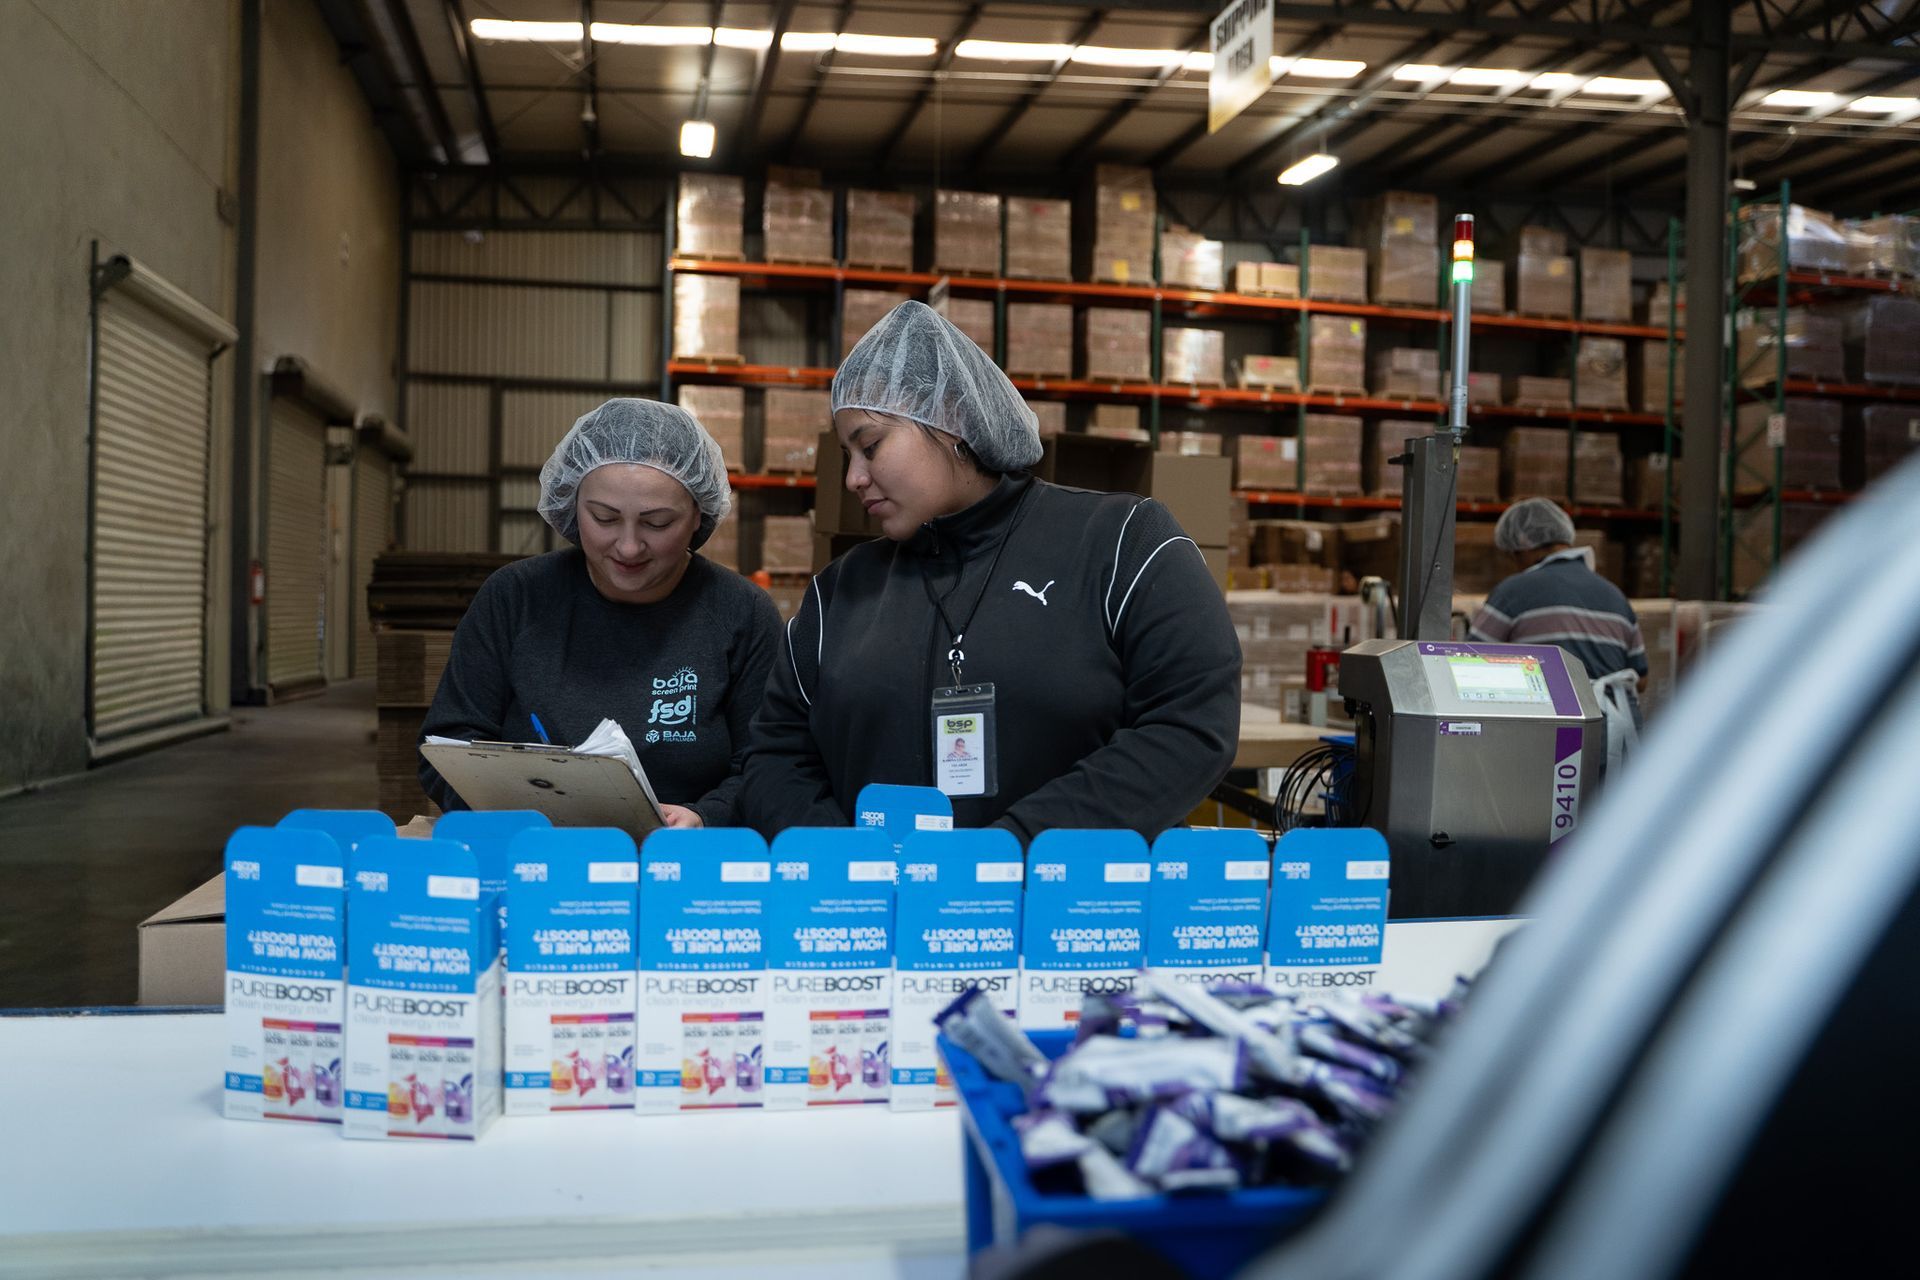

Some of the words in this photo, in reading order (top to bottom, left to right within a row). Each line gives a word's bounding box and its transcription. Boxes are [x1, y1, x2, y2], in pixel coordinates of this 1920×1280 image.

[653, 673, 698, 689] baja
[652, 687, 678, 695] screen
[679, 684, 697, 693] print
[648, 695, 691, 723] fsd
[947, 720, 973, 729] bsp
[1555, 764, 1577, 828] 9410
[591, 929, 630, 943] YOUR
[722, 928, 761, 943] YOUR
[849, 927, 887, 941] YOUR
[977, 928, 1014, 942] YOUR
[1104, 928, 1140, 942] YOUR
[1224, 925, 1259, 939] YOUR
[1345, 924, 1379, 938] YOUR
[299, 934, 336, 952] YOUR
[594, 942, 630, 954] HOW
[672, 941, 687, 954] IS
[688, 941, 724, 954] PURE
[726, 941, 761, 953] HOW
[800, 940, 813, 952] IS
[815, 940, 851, 952] PURE
[853, 939, 887, 951] HOW
[929, 941, 941, 953] IS
[943, 941, 978, 953] PURE
[980, 940, 1014, 952] HOW
[1057, 941, 1069, 952] IS
[1071, 941, 1106, 952] PURE
[1107, 940, 1140, 952] HOW
[1179, 938, 1190, 950] IS
[1193, 937, 1226, 950] PURE
[1227, 937, 1259, 948] HOW
[1301, 937, 1313, 948] IS
[1315, 936, 1348, 948] PURE
[1348, 936, 1379, 947] HOW
[253, 942, 264, 955] IS
[267, 944, 302, 959] PURE
[302, 947, 336, 961] HOW
[540, 942, 554, 955] IS
[555, 942, 594, 955] PURE
[379, 956, 394, 969] IS
[429, 947, 470, 965] YOUR
[394, 957, 431, 972] PURE
[433, 960, 470, 975] HOW
[646, 977, 759, 994] PUREBOOST
[773, 976, 884, 992] PUREBOOST
[1030, 976, 1138, 993] PUREBOOST
[1275, 971, 1377, 988] PUREBOOST
[231, 978, 337, 1002] PUREBOOST
[513, 978, 629, 995] PUREBOOST
[354, 992, 468, 1017] PUREBOOST
